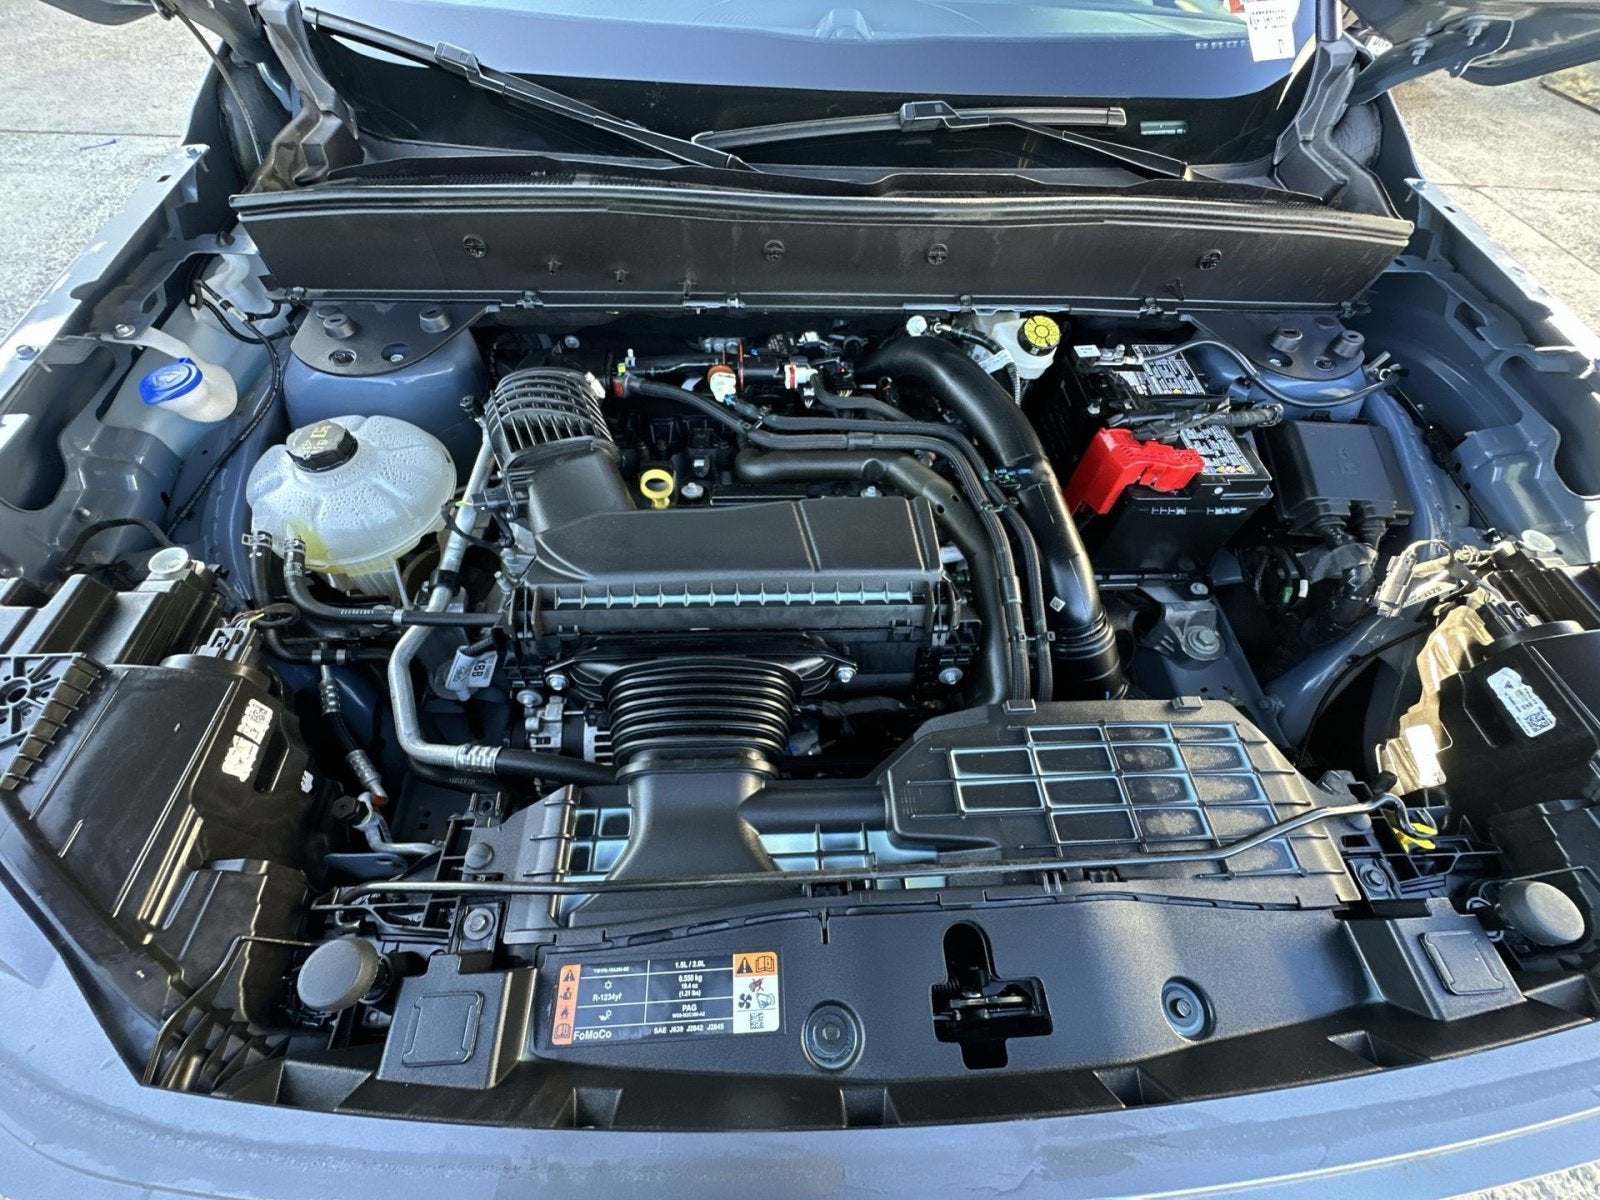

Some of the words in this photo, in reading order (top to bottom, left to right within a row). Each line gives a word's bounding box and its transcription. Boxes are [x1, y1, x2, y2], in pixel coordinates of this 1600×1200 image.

[694, 973, 703, 983] kg
[592, 992, 622, 1002] R-1234yf
[681, 1004, 697, 1012] PAG
[573, 1029, 612, 1040] FoMoCo
[653, 1026, 667, 1034] SAE
